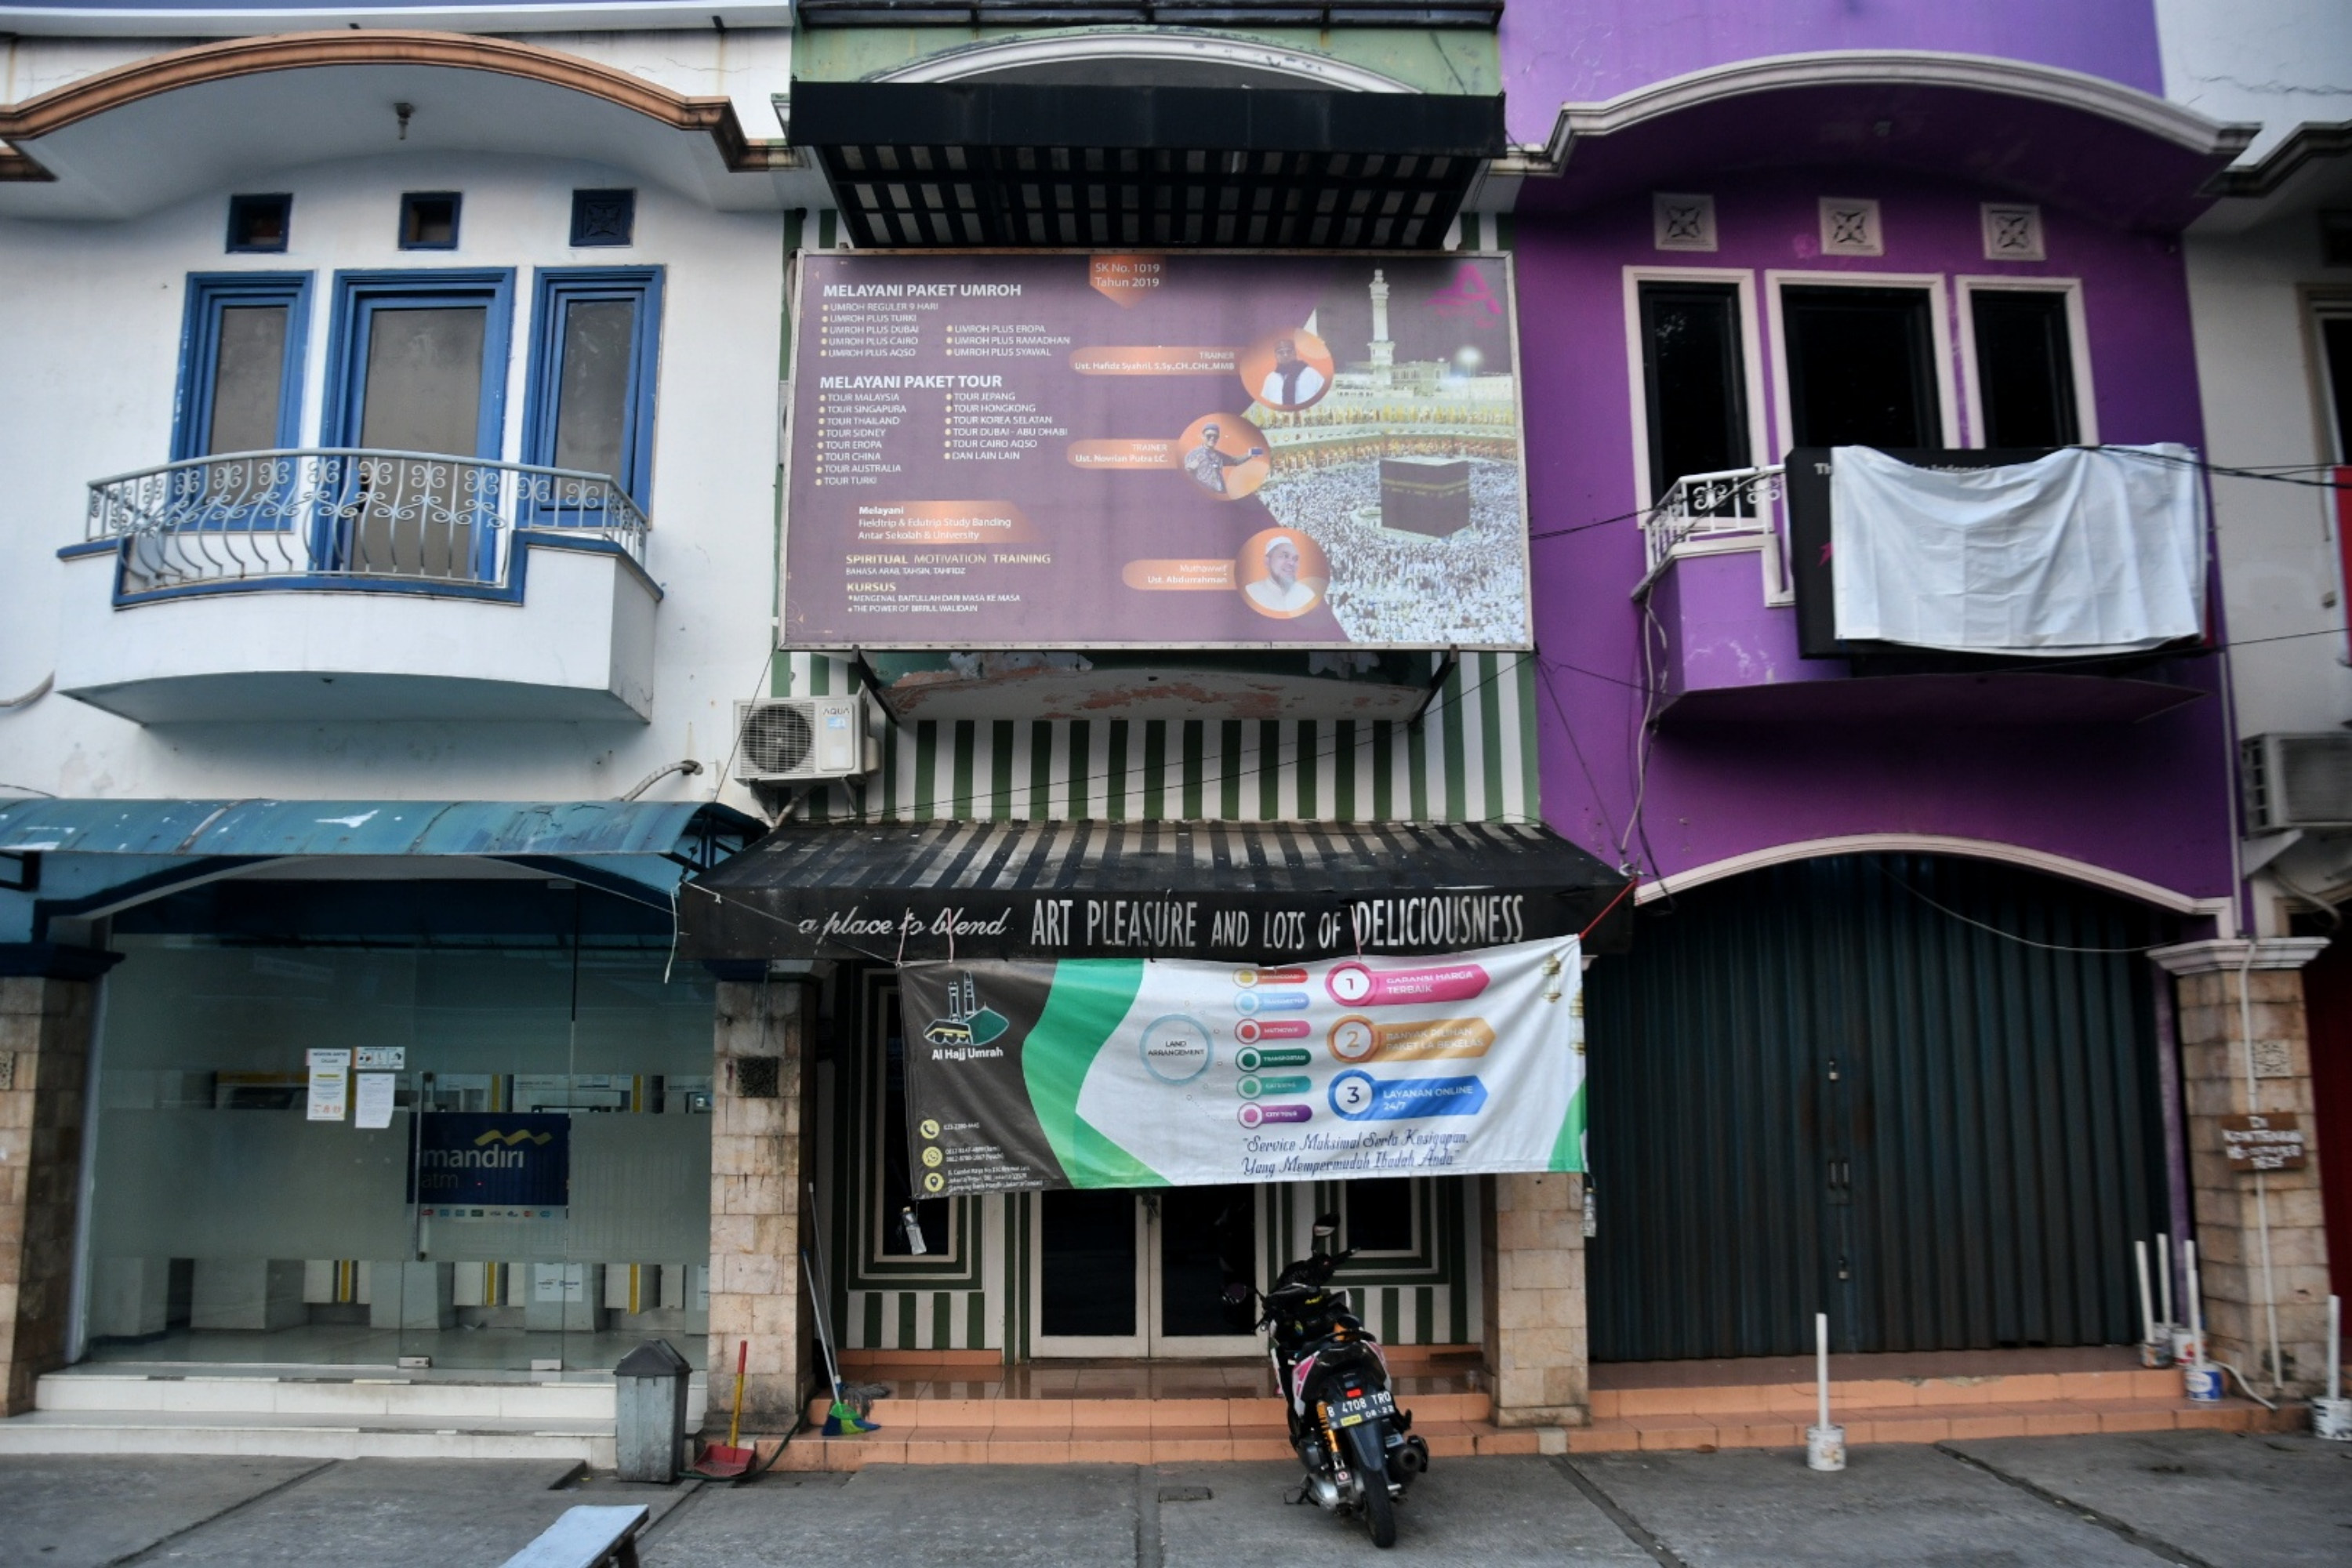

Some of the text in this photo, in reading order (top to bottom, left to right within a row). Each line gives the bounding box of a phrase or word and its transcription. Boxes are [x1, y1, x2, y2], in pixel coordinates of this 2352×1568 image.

[1095, 263, 1160, 273] SK No. 1019
[1095, 278, 1160, 287] Tahun 2019
[823, 285, 1022, 297] MELAYANI PAKET UMROH
[830, 303, 938, 311] UMROH REGULER 9 HARI
[830, 325, 919, 334] UMROH PLUS DUBAI
[955, 325, 1046, 333] UMROH PLUS EROPA
[829, 337, 918, 346] UMROH PLUS CAIRO
[955, 336, 1070, 345] UMROH PLUS RAMADHAN
[829, 349, 916, 358] UMROH PLUS AQSO
[820, 376, 1003, 388] MELAYANI PAKET TOUR
[954, 392, 1015, 401] TOUR JEPANG
[827, 416, 900, 425] TOUR THAILAND
[826, 429, 886, 437] TOUR SIDNEY
[826, 441, 882, 449] TOUR EROPA
[953, 440, 1037, 448] TOUR CAIRO AQSO
[825, 452, 881, 461] TOUR CHINA
[824, 464, 901, 473] TOUR AUSTRALIA
[824, 477, 877, 485] TOUR TURKI
[858, 506, 904, 517] Melayani
[858, 518, 1011, 528] Fieldtrip & Edutrip Study Banding
[858, 531, 979, 540] Antar Sekolah & University
[846, 555, 1051, 564] SPIRITUAL MOTIVATION TRAINING
[847, 583, 896, 591] KURSUS
[798, 895, 1523, 949] a place to blend ART PLEASURE AND LOTS OF DELICIOUSNESS
[1386, 971, 1474, 984] GARANSI HARGA
[1345, 978, 1354, 989] 1
[1386, 985, 1432, 994] TERBAIK
[1346, 1030, 1359, 1047] 2
[1386, 1042, 1419, 1051] PAKET
[931, 1047, 1004, 1062] Al Hajj Umrah
[1347, 1087, 1359, 1104] 3
[1383, 1086, 1473, 1098] LAYANAN ONLINE
[1384, 1102, 1406, 1110] 24/7
[1299, 1132, 1363, 1151] Maksimal
[1363, 1132, 1399, 1148] Serta
[422, 1144, 524, 1168] mandiri
[1241, 1156, 1276, 1178] Yang
[1279, 1152, 1370, 1175] Mempermudah
[1374, 1149, 1415, 1168] Ibadah
[422, 1174, 459, 1189] atm
[1327, 1398, 1367, 1417] B 4708
